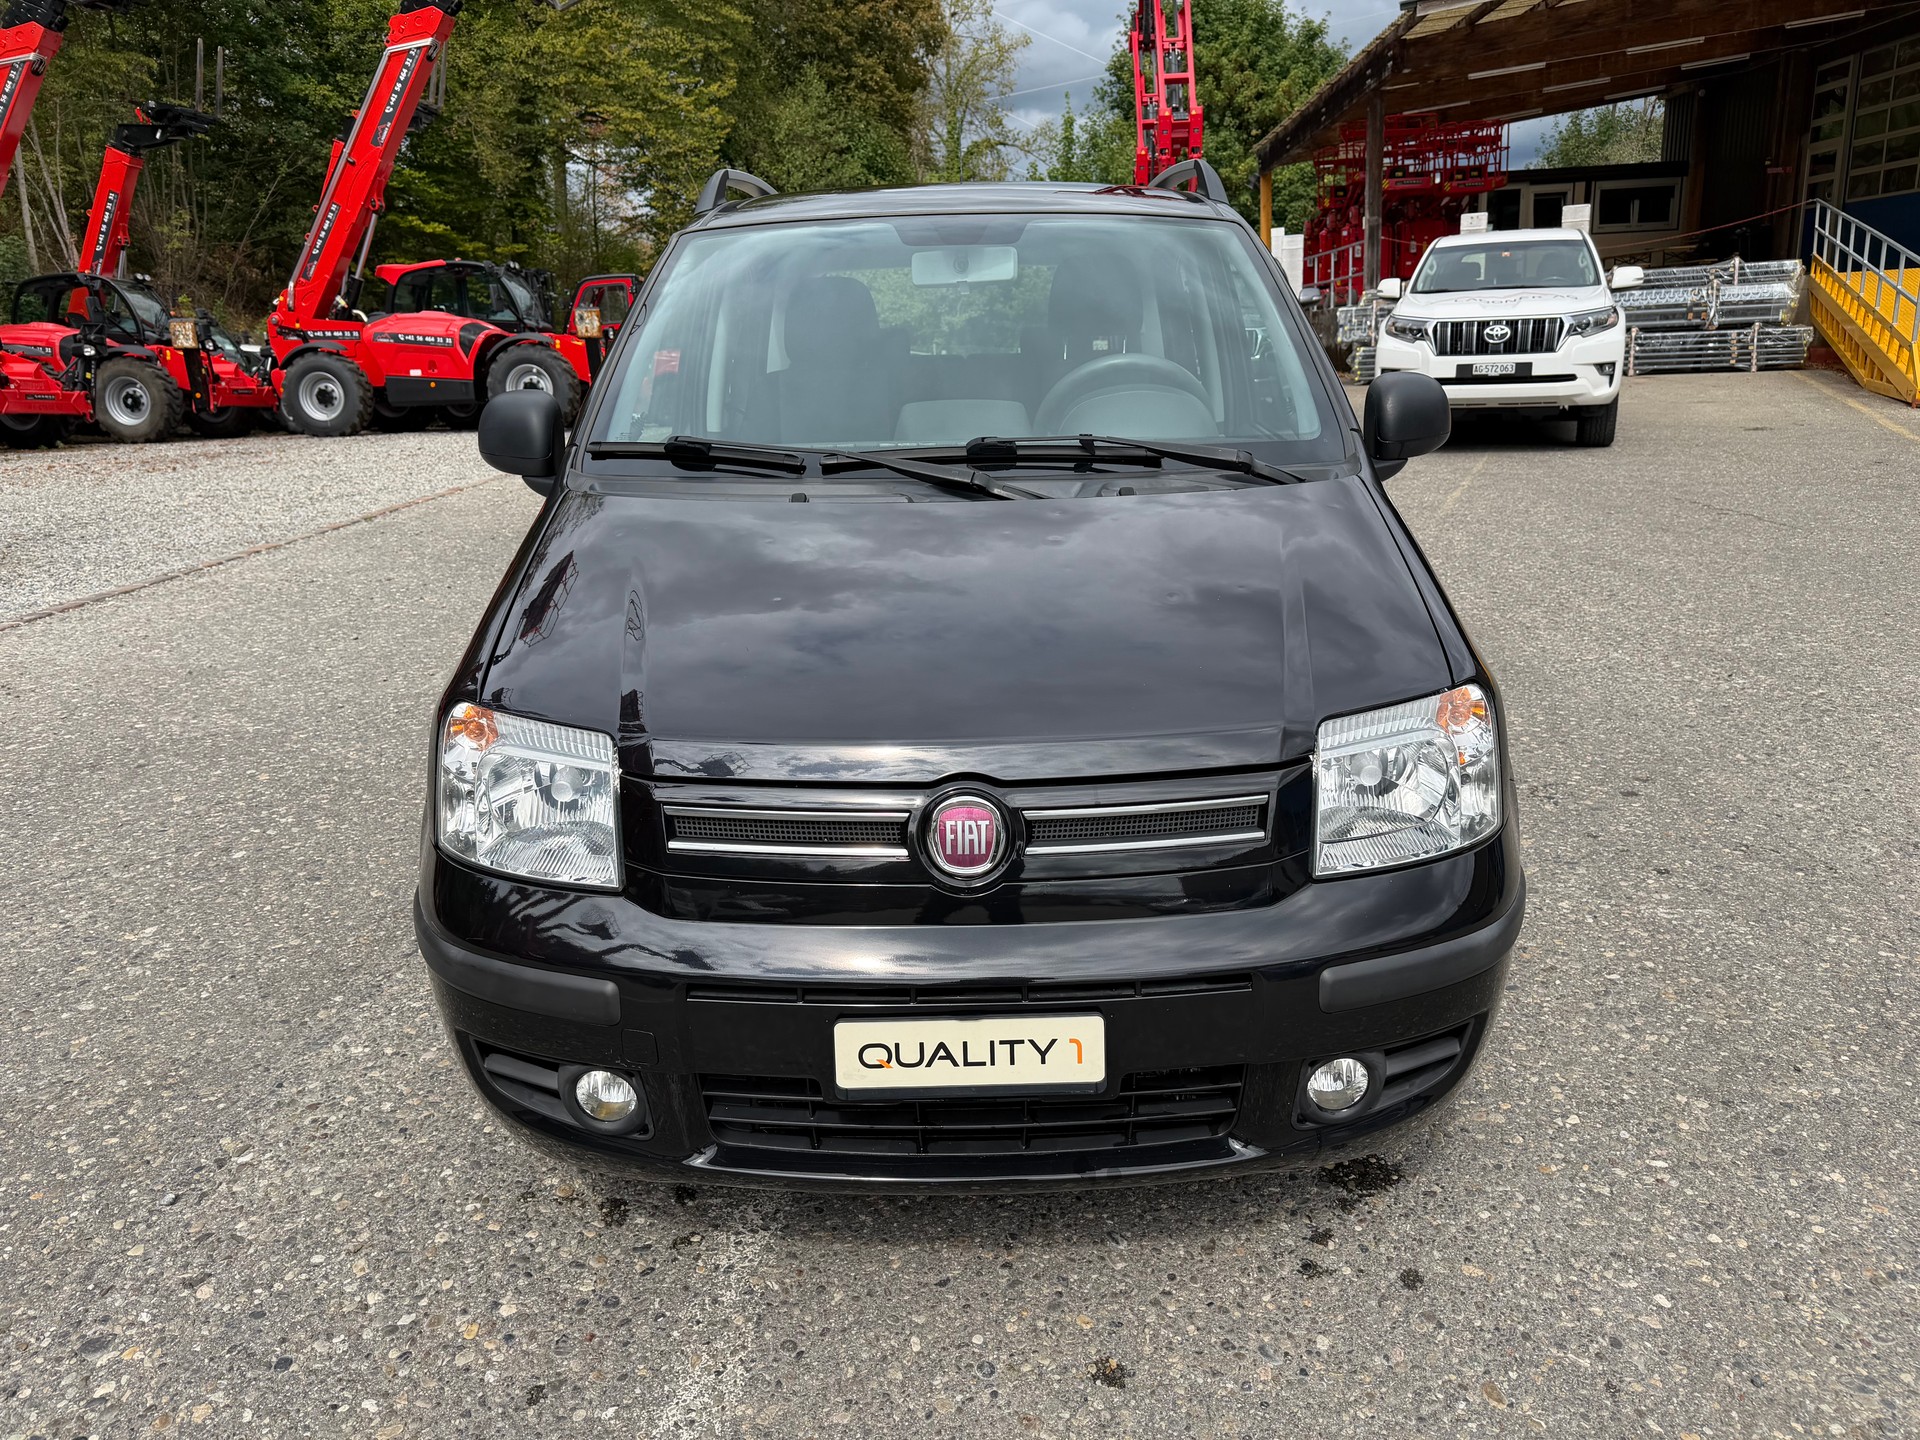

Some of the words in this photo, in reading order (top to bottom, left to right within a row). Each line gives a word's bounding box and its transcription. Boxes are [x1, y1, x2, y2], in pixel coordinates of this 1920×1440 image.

[9, 70, 17, 79] 31
[395, 82, 402, 92] 56
[399, 69, 408, 81] 464
[405, 58, 413, 66] 31
[945, 820, 990, 855] FIAT
[858, 1038, 1058, 1069] QUALITY
[1069, 1038, 1083, 1065] 1
